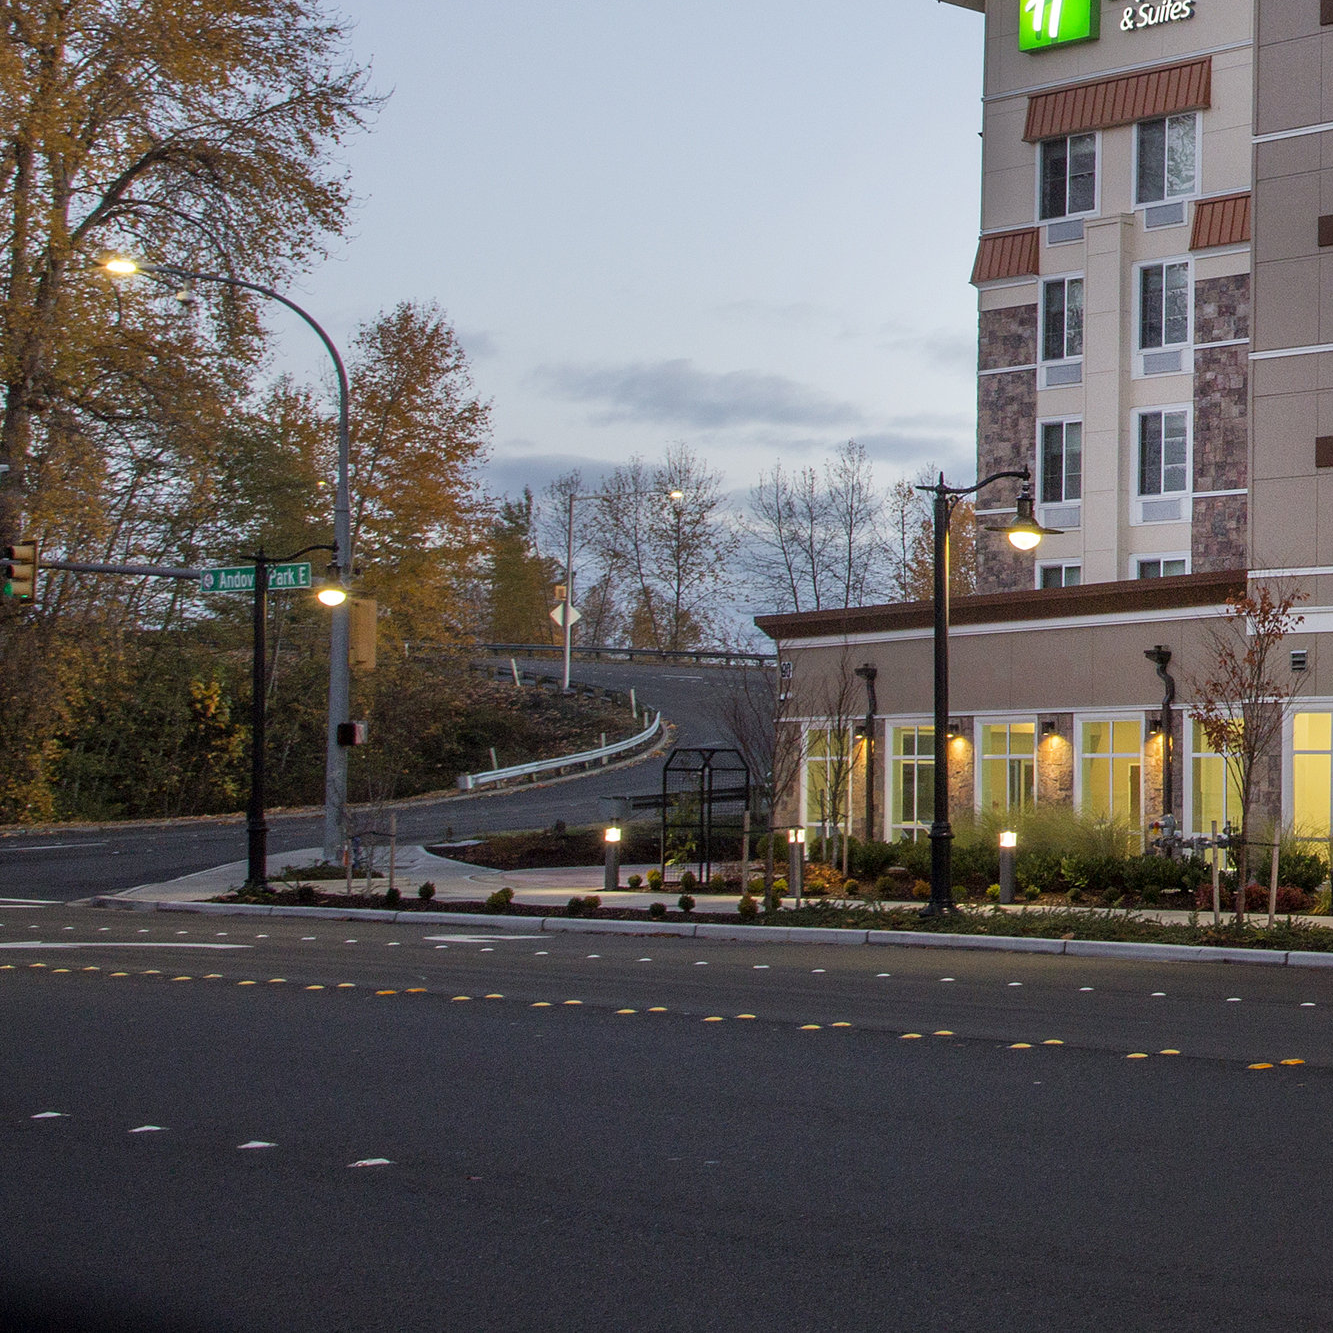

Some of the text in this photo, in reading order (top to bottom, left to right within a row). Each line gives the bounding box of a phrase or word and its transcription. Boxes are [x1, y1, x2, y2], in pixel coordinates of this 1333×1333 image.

[1120, 6, 1134, 31] &
[219, 566, 306, 589] Andov Park E
